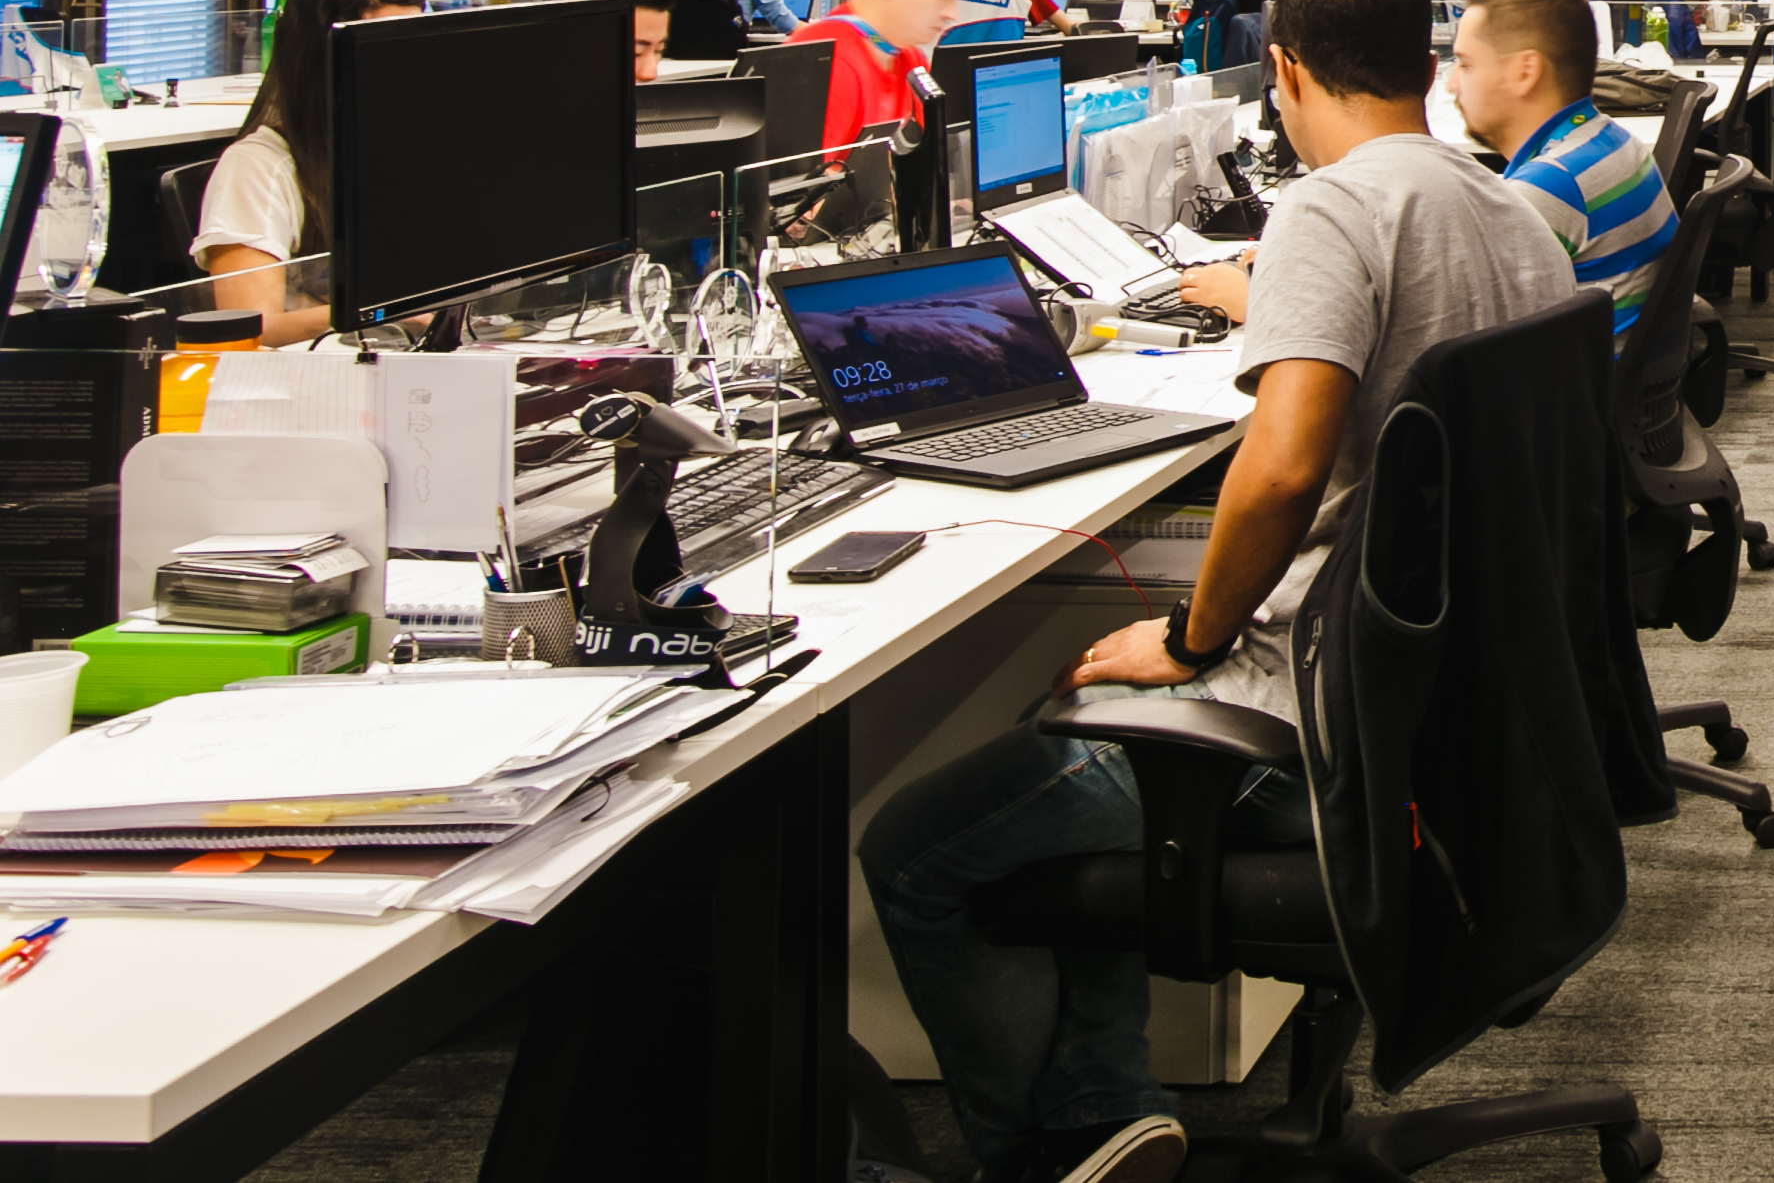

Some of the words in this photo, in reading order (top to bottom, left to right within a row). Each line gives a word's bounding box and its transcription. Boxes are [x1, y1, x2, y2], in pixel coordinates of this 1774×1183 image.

[833, 360, 892, 388] 09:28
[844, 388, 893, 403] terça-feira,
[907, 381, 919, 391] de
[920, 376, 948, 387] março
[142, 407, 151, 436] ADM
